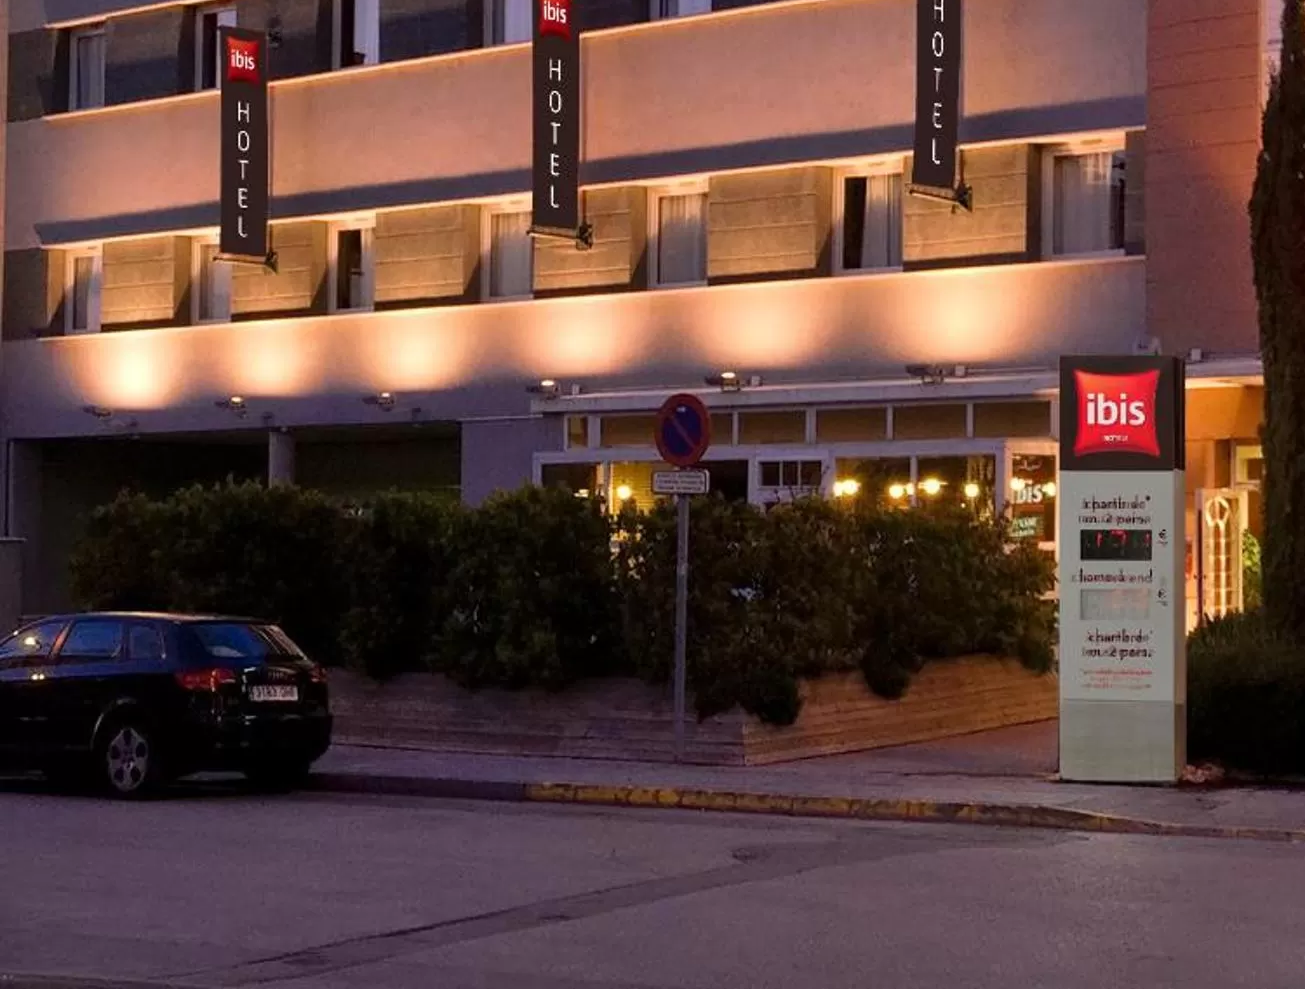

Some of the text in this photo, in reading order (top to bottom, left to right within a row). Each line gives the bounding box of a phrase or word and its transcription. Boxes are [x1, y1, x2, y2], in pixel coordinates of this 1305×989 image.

[543, 0, 567, 24] ibis
[230, 48, 255, 70] ibis
[548, 58, 562, 209] HOTEL
[237, 101, 250, 238] HOTEL
[1087, 392, 1146, 426] ibis
